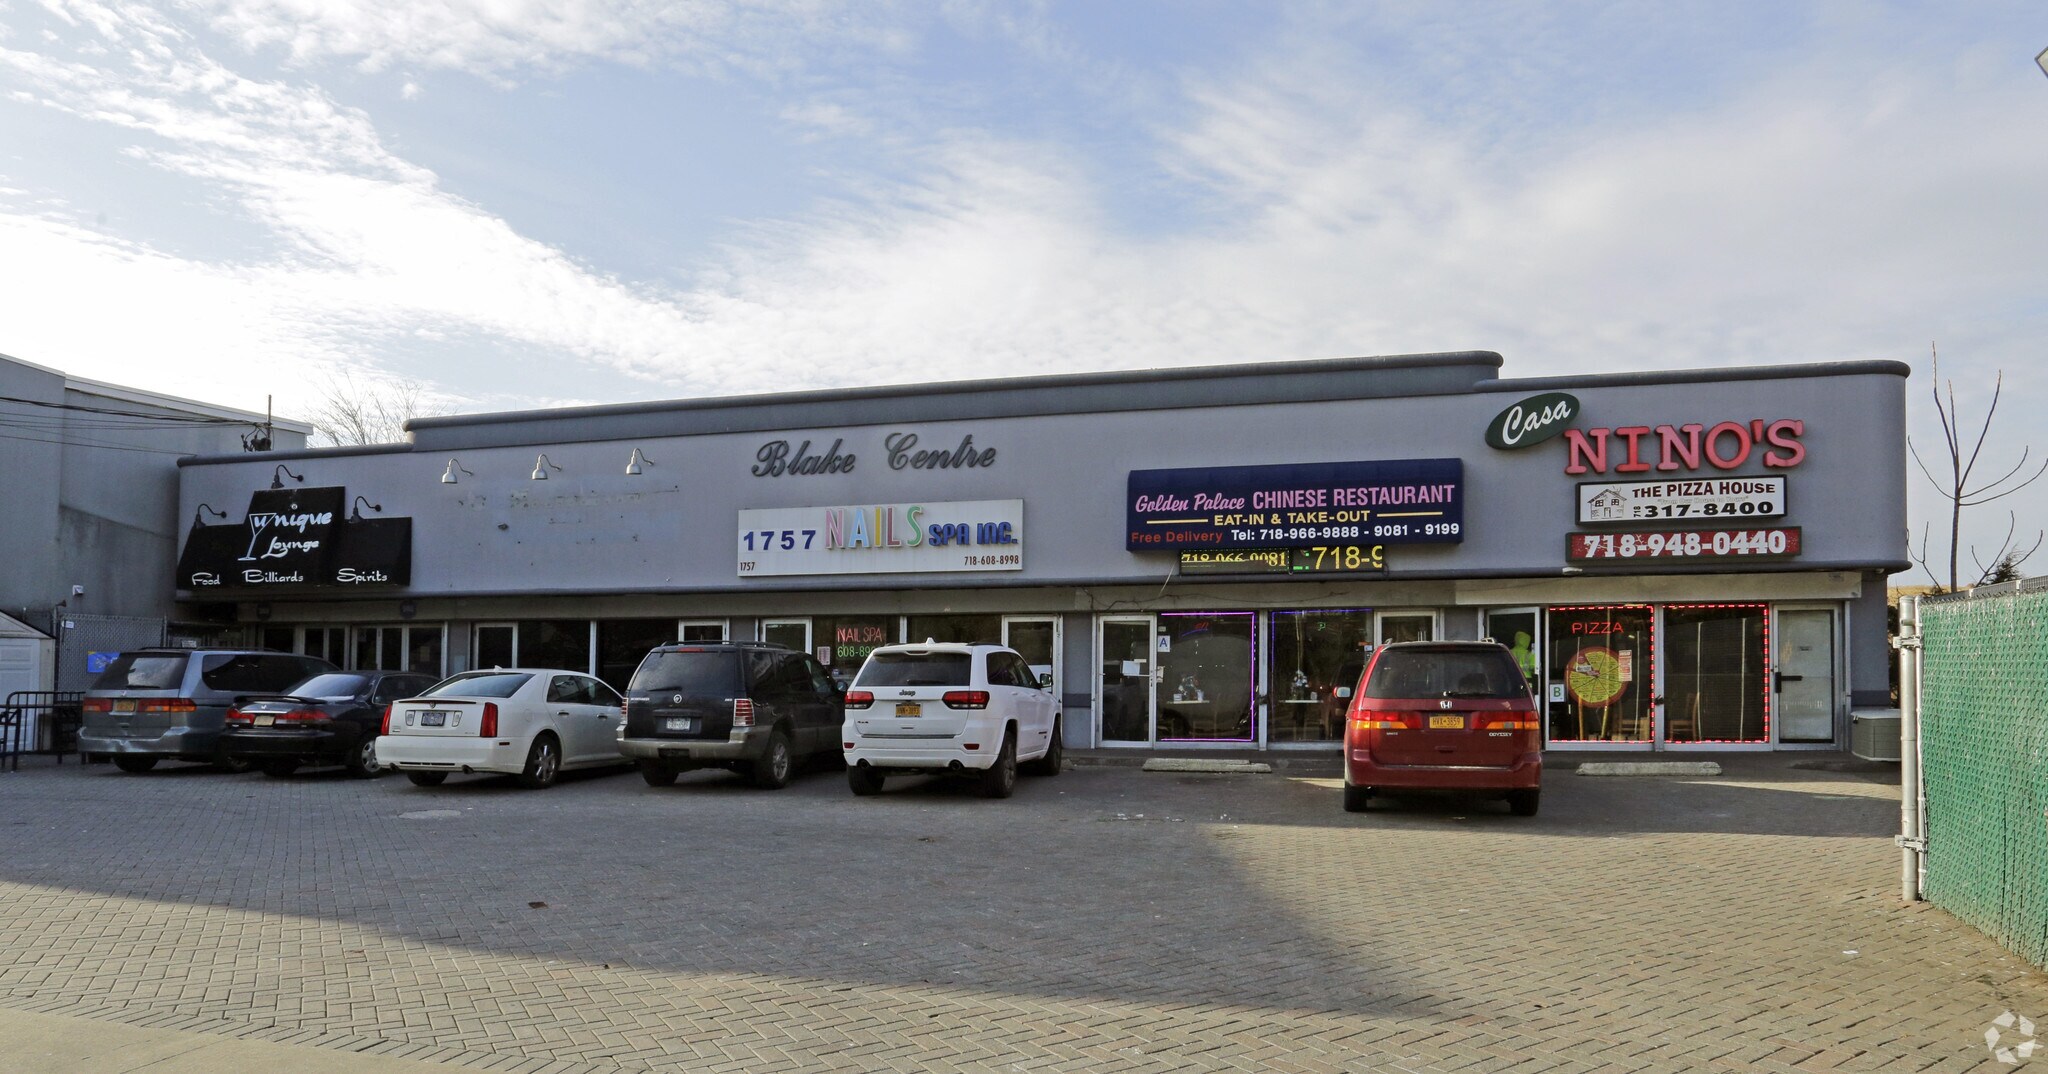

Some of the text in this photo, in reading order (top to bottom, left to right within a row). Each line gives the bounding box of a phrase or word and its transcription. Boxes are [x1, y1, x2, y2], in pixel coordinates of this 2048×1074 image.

[1502, 400, 1571, 445] Casa
[751, 432, 997, 477] Blake Centre
[1564, 419, 1806, 475] NINO'S
[1135, 484, 1456, 512] Golden Palace CHINESE RESTAURANT
[1632, 482, 1775, 498] THE PIZZA HOUSE
[1644, 501, 1774, 518] 317-8400
[1214, 510, 1371, 527] EAT-IN & TAKE-OUT
[743, 530, 816, 551] 1757
[825, 506, 923, 549] NAILS
[928, 522, 970, 547] SPA
[1131, 530, 1223, 544] Free Delivery
[1231, 529, 1255, 541] Tel:
[1259, 525, 1359, 540] 718-966-9888
[1374, 525, 1408, 537] 9081
[1425, 523, 1460, 535] 9199
[260, 536, 320, 559] Lounge
[1584, 530, 1786, 558] 718-948-0440
[739, 562, 756, 571] 1757
[964, 555, 1020, 566] 718-608-8998
[191, 568, 388, 585] Food Billiards Spirits
[837, 627, 883, 642] NAIL SPA
[1572, 622, 1624, 634] PIZZA
[1159, 637, 1168, 648] A
[1553, 686, 1561, 697] B
